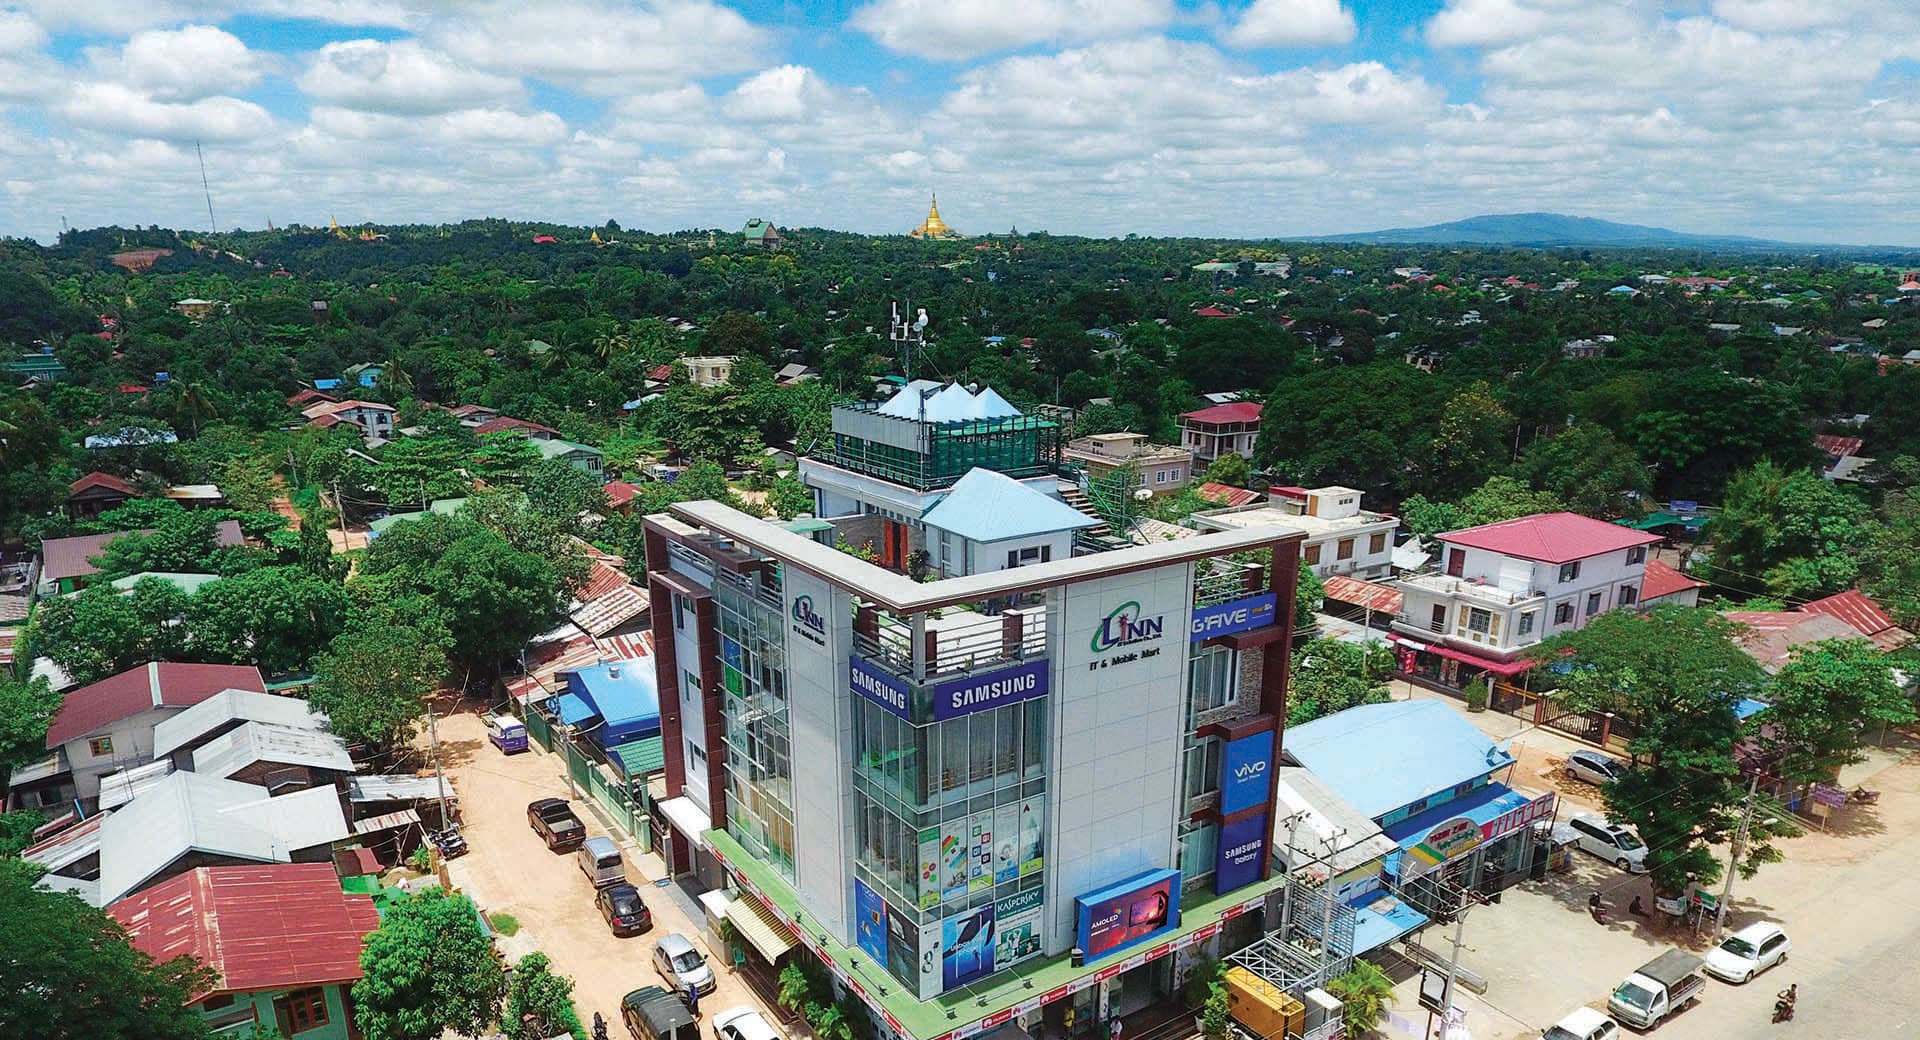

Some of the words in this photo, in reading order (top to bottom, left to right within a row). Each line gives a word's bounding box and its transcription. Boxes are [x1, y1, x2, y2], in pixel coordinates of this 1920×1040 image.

[1090, 661, 1099, 671] IT
[1101, 659, 1107, 668] &
[1112, 653, 1138, 666] Mobile
[1141, 648, 1160, 659] Mart
[852, 668, 905, 709] SAMSUNG
[952, 673, 1036, 709] SAMSUNG
[1225, 839, 1262, 859] SAMSUNG
[1235, 852, 1257, 865] Galaxy
[1091, 914, 1119, 930] AMOLED
